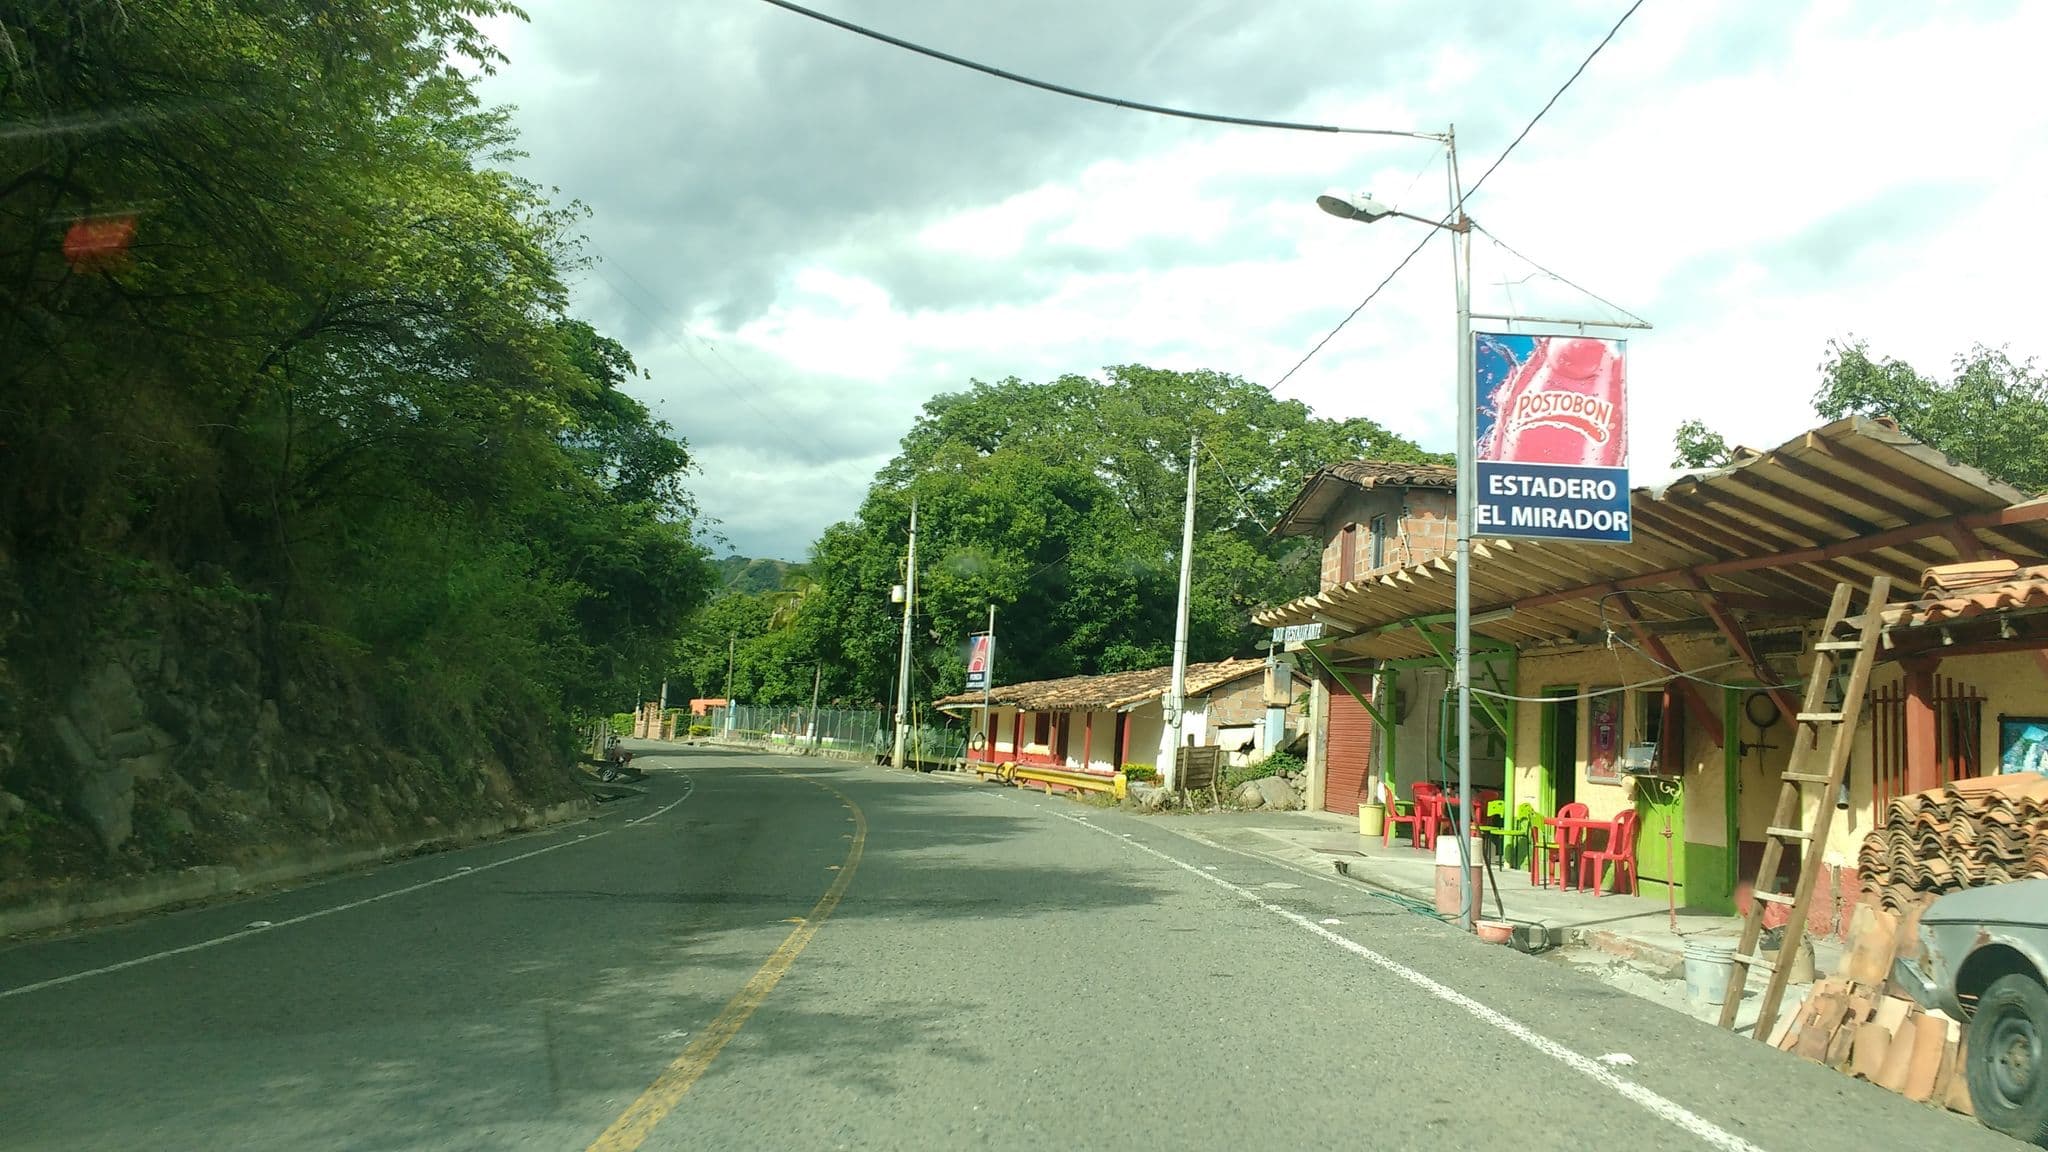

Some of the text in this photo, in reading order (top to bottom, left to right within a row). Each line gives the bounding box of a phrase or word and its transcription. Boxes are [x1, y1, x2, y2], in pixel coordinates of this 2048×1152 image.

[1518, 393, 1611, 425] POSTOBON
[1489, 475, 1616, 501] ESTADERO
[1478, 504, 1629, 532] EL MIRADOR
